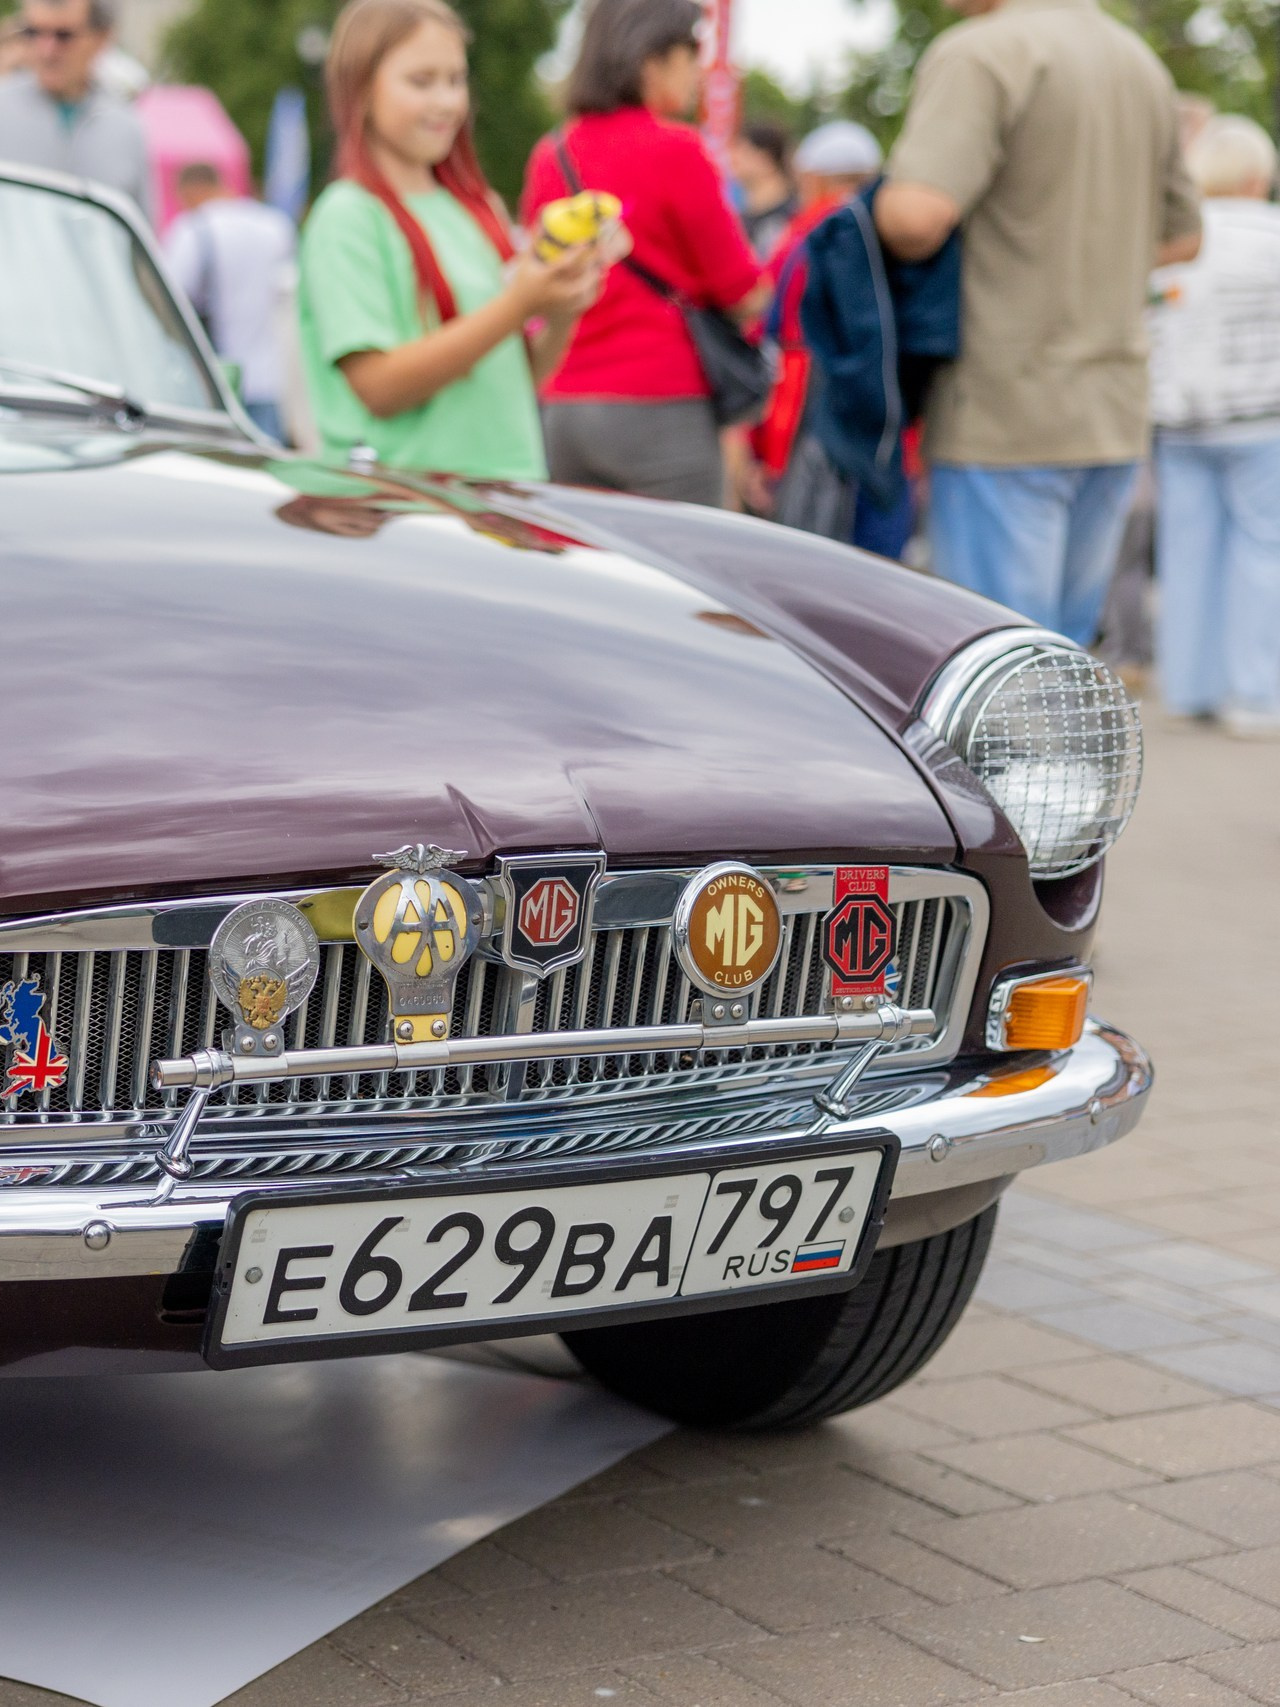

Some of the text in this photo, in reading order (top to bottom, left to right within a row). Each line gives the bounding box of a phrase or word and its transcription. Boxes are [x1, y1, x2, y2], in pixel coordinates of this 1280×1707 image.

[707, 875, 765, 898] OWNERS
[839, 869, 886, 880] DRIVERS
[848, 881, 877, 891] CLUB
[384, 877, 465, 956] AA
[524, 883, 574, 939] MG
[705, 894, 764, 967] MG
[834, 905, 888, 972] MG
[714, 969, 753, 985] CLUB
[262, 1166, 855, 1325] E629BA 797
[722, 1249, 791, 1280] RUS
